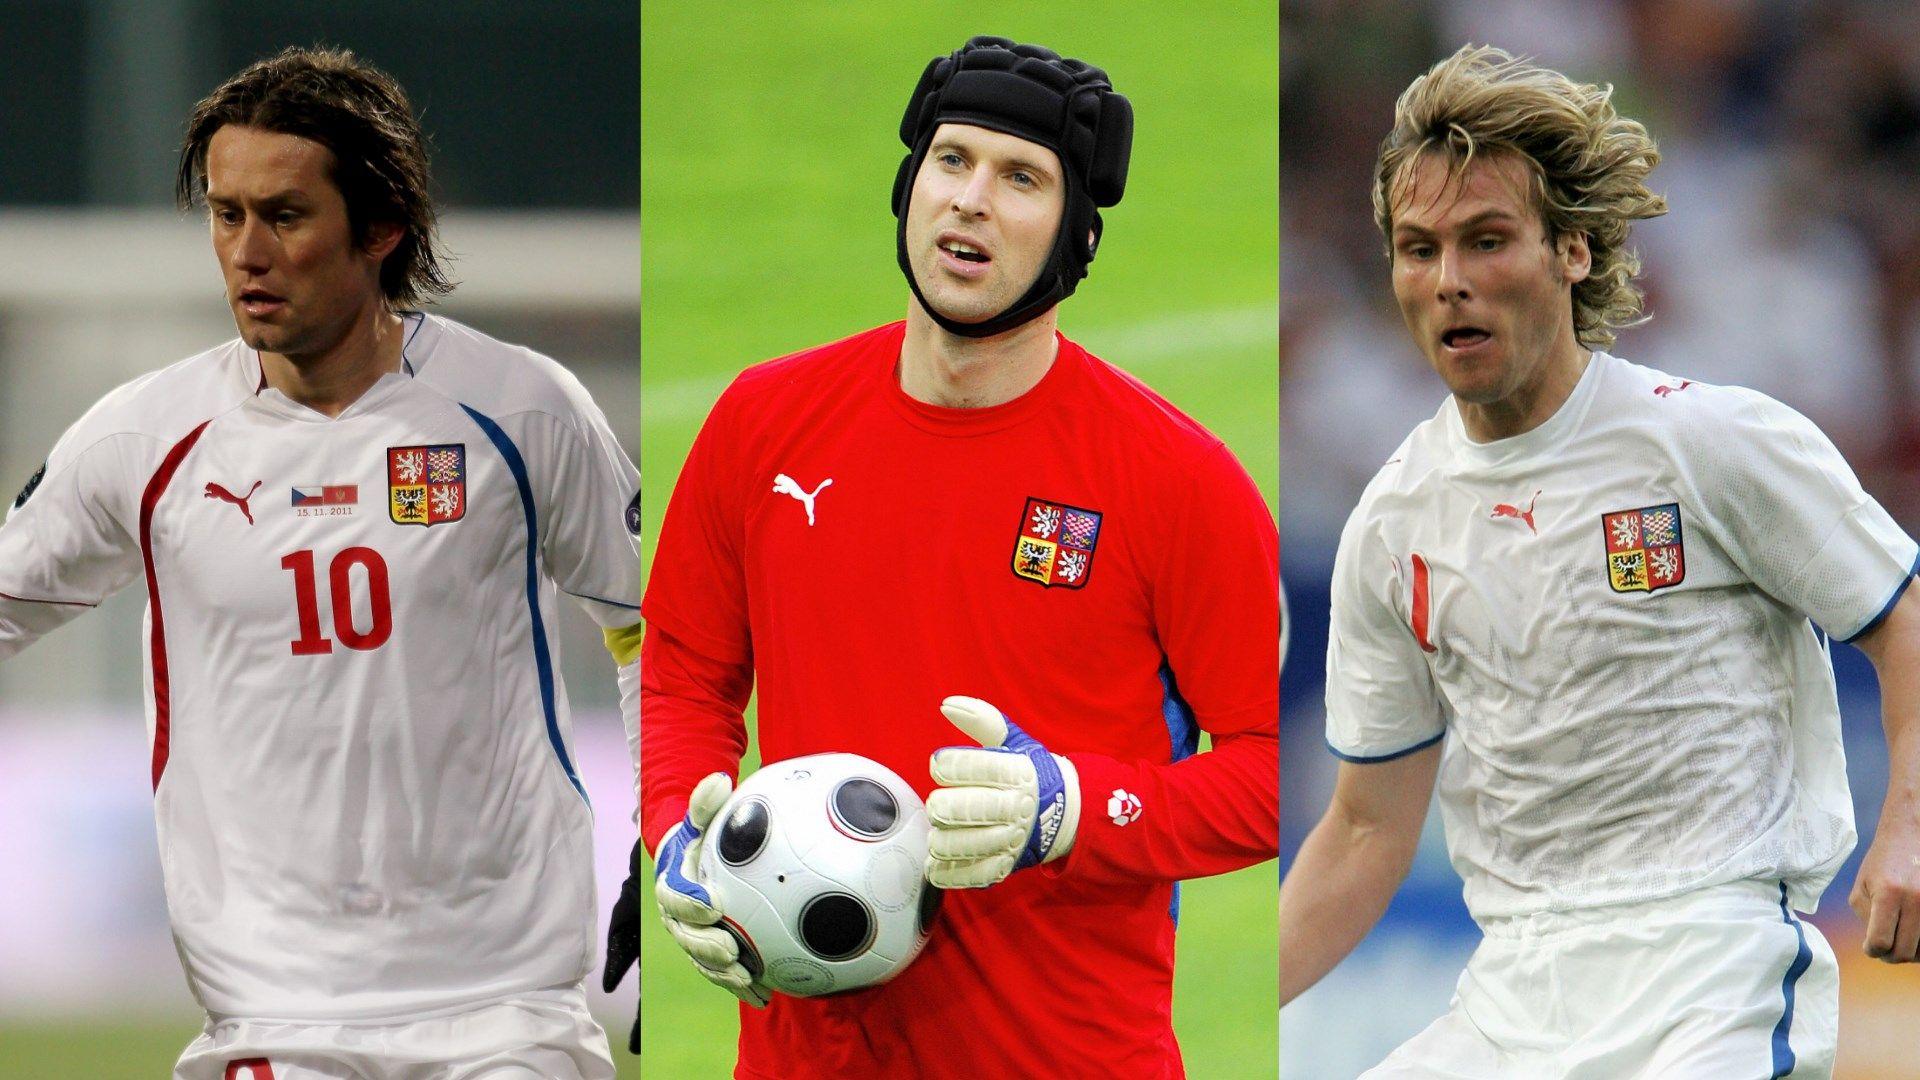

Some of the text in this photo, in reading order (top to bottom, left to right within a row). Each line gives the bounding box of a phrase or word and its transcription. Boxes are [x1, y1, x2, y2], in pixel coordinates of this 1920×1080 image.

[330, 507, 353, 516] 2011
[281, 546, 393, 656] 10
[1040, 792, 1064, 852] adidas
